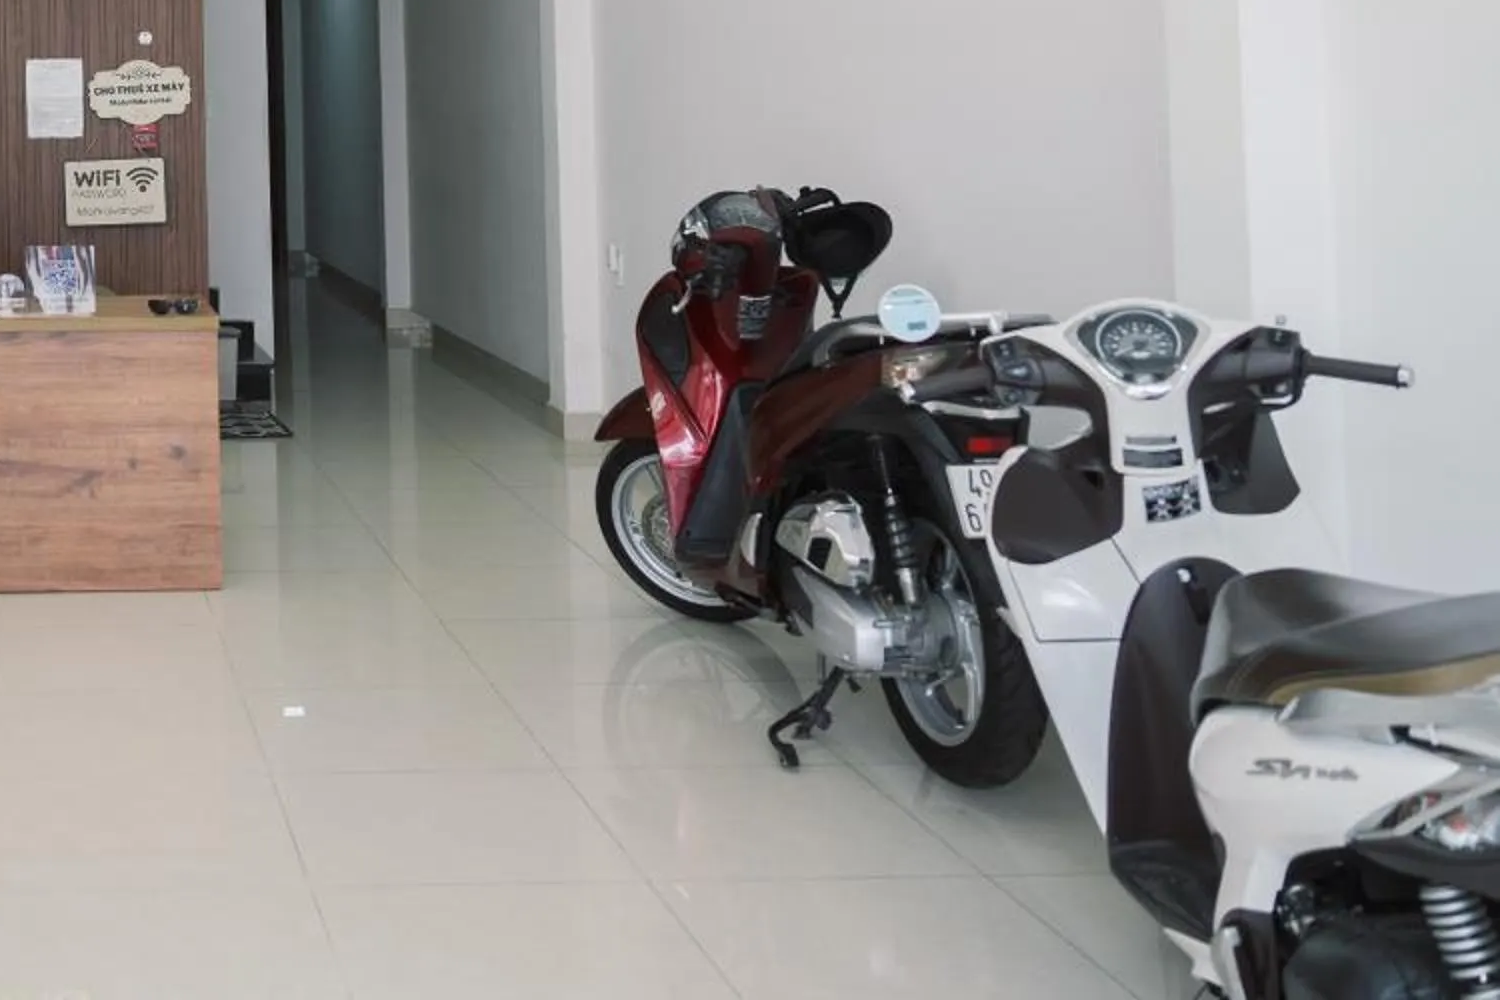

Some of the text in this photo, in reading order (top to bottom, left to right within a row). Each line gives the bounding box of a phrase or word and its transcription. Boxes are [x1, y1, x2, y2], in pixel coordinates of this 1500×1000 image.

[93, 86, 116, 97] CHO
[116, 82, 144, 95] THUÊ
[145, 83, 160, 93] XE
[73, 168, 122, 189] WiFi
